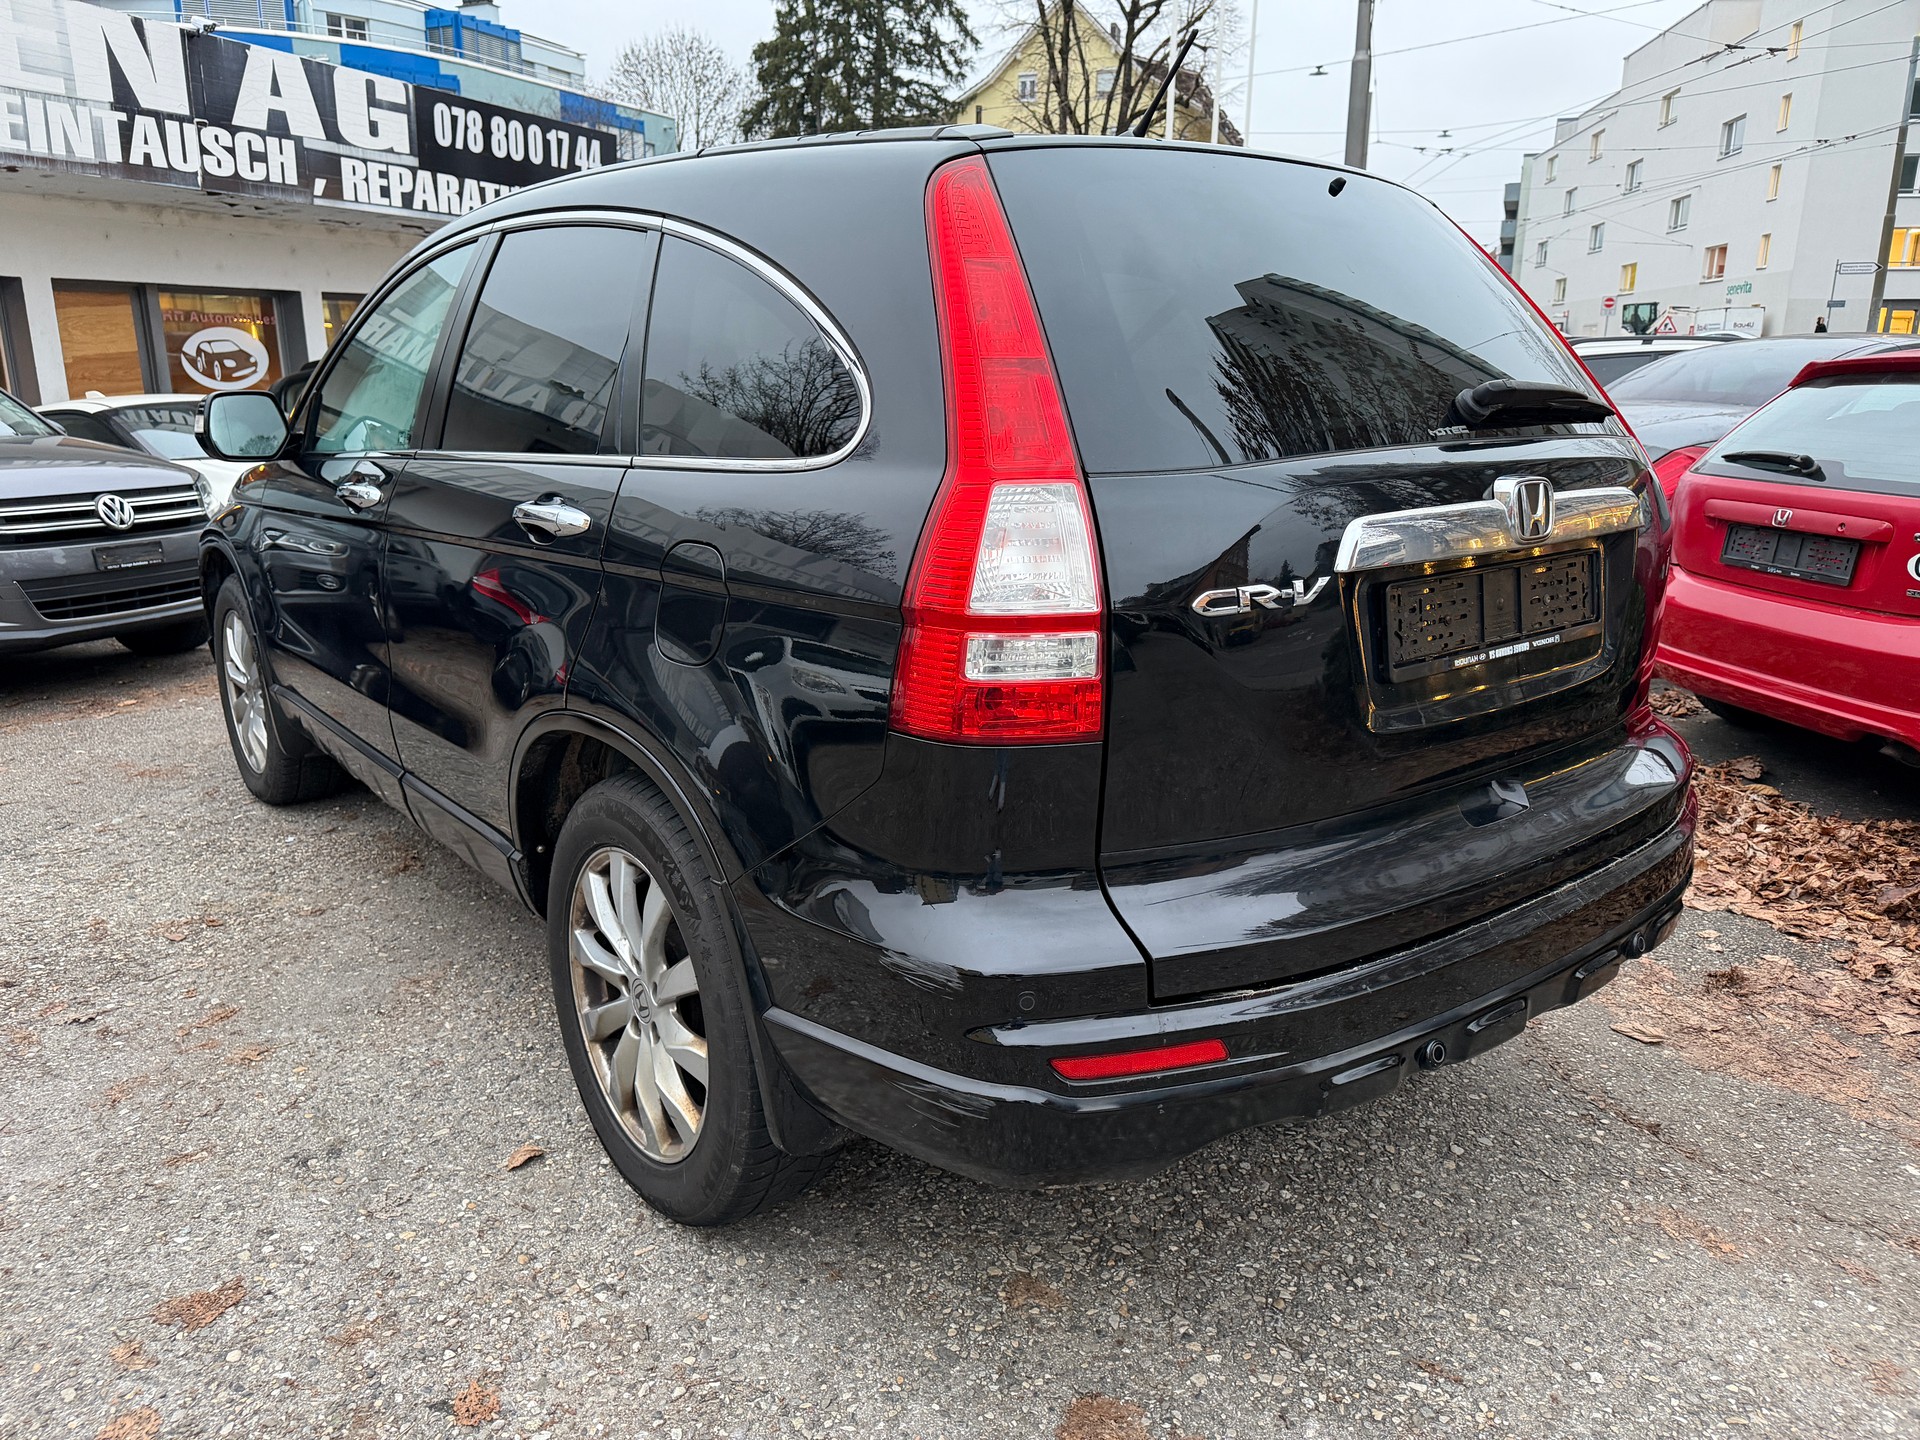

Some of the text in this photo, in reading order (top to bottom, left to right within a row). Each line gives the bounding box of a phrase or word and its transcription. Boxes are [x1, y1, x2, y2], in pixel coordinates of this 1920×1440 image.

[232, 45, 411, 154] AG
[0, 91, 298, 186] EINTAUSCH
[340, 156, 522, 215] REPARAT
[433, 103, 603, 172] 078 800 17 44
[1726, 280, 1752, 296] senevita
[189, 310, 277, 326] Automes
[1191, 576, 1331, 617] CR-V
